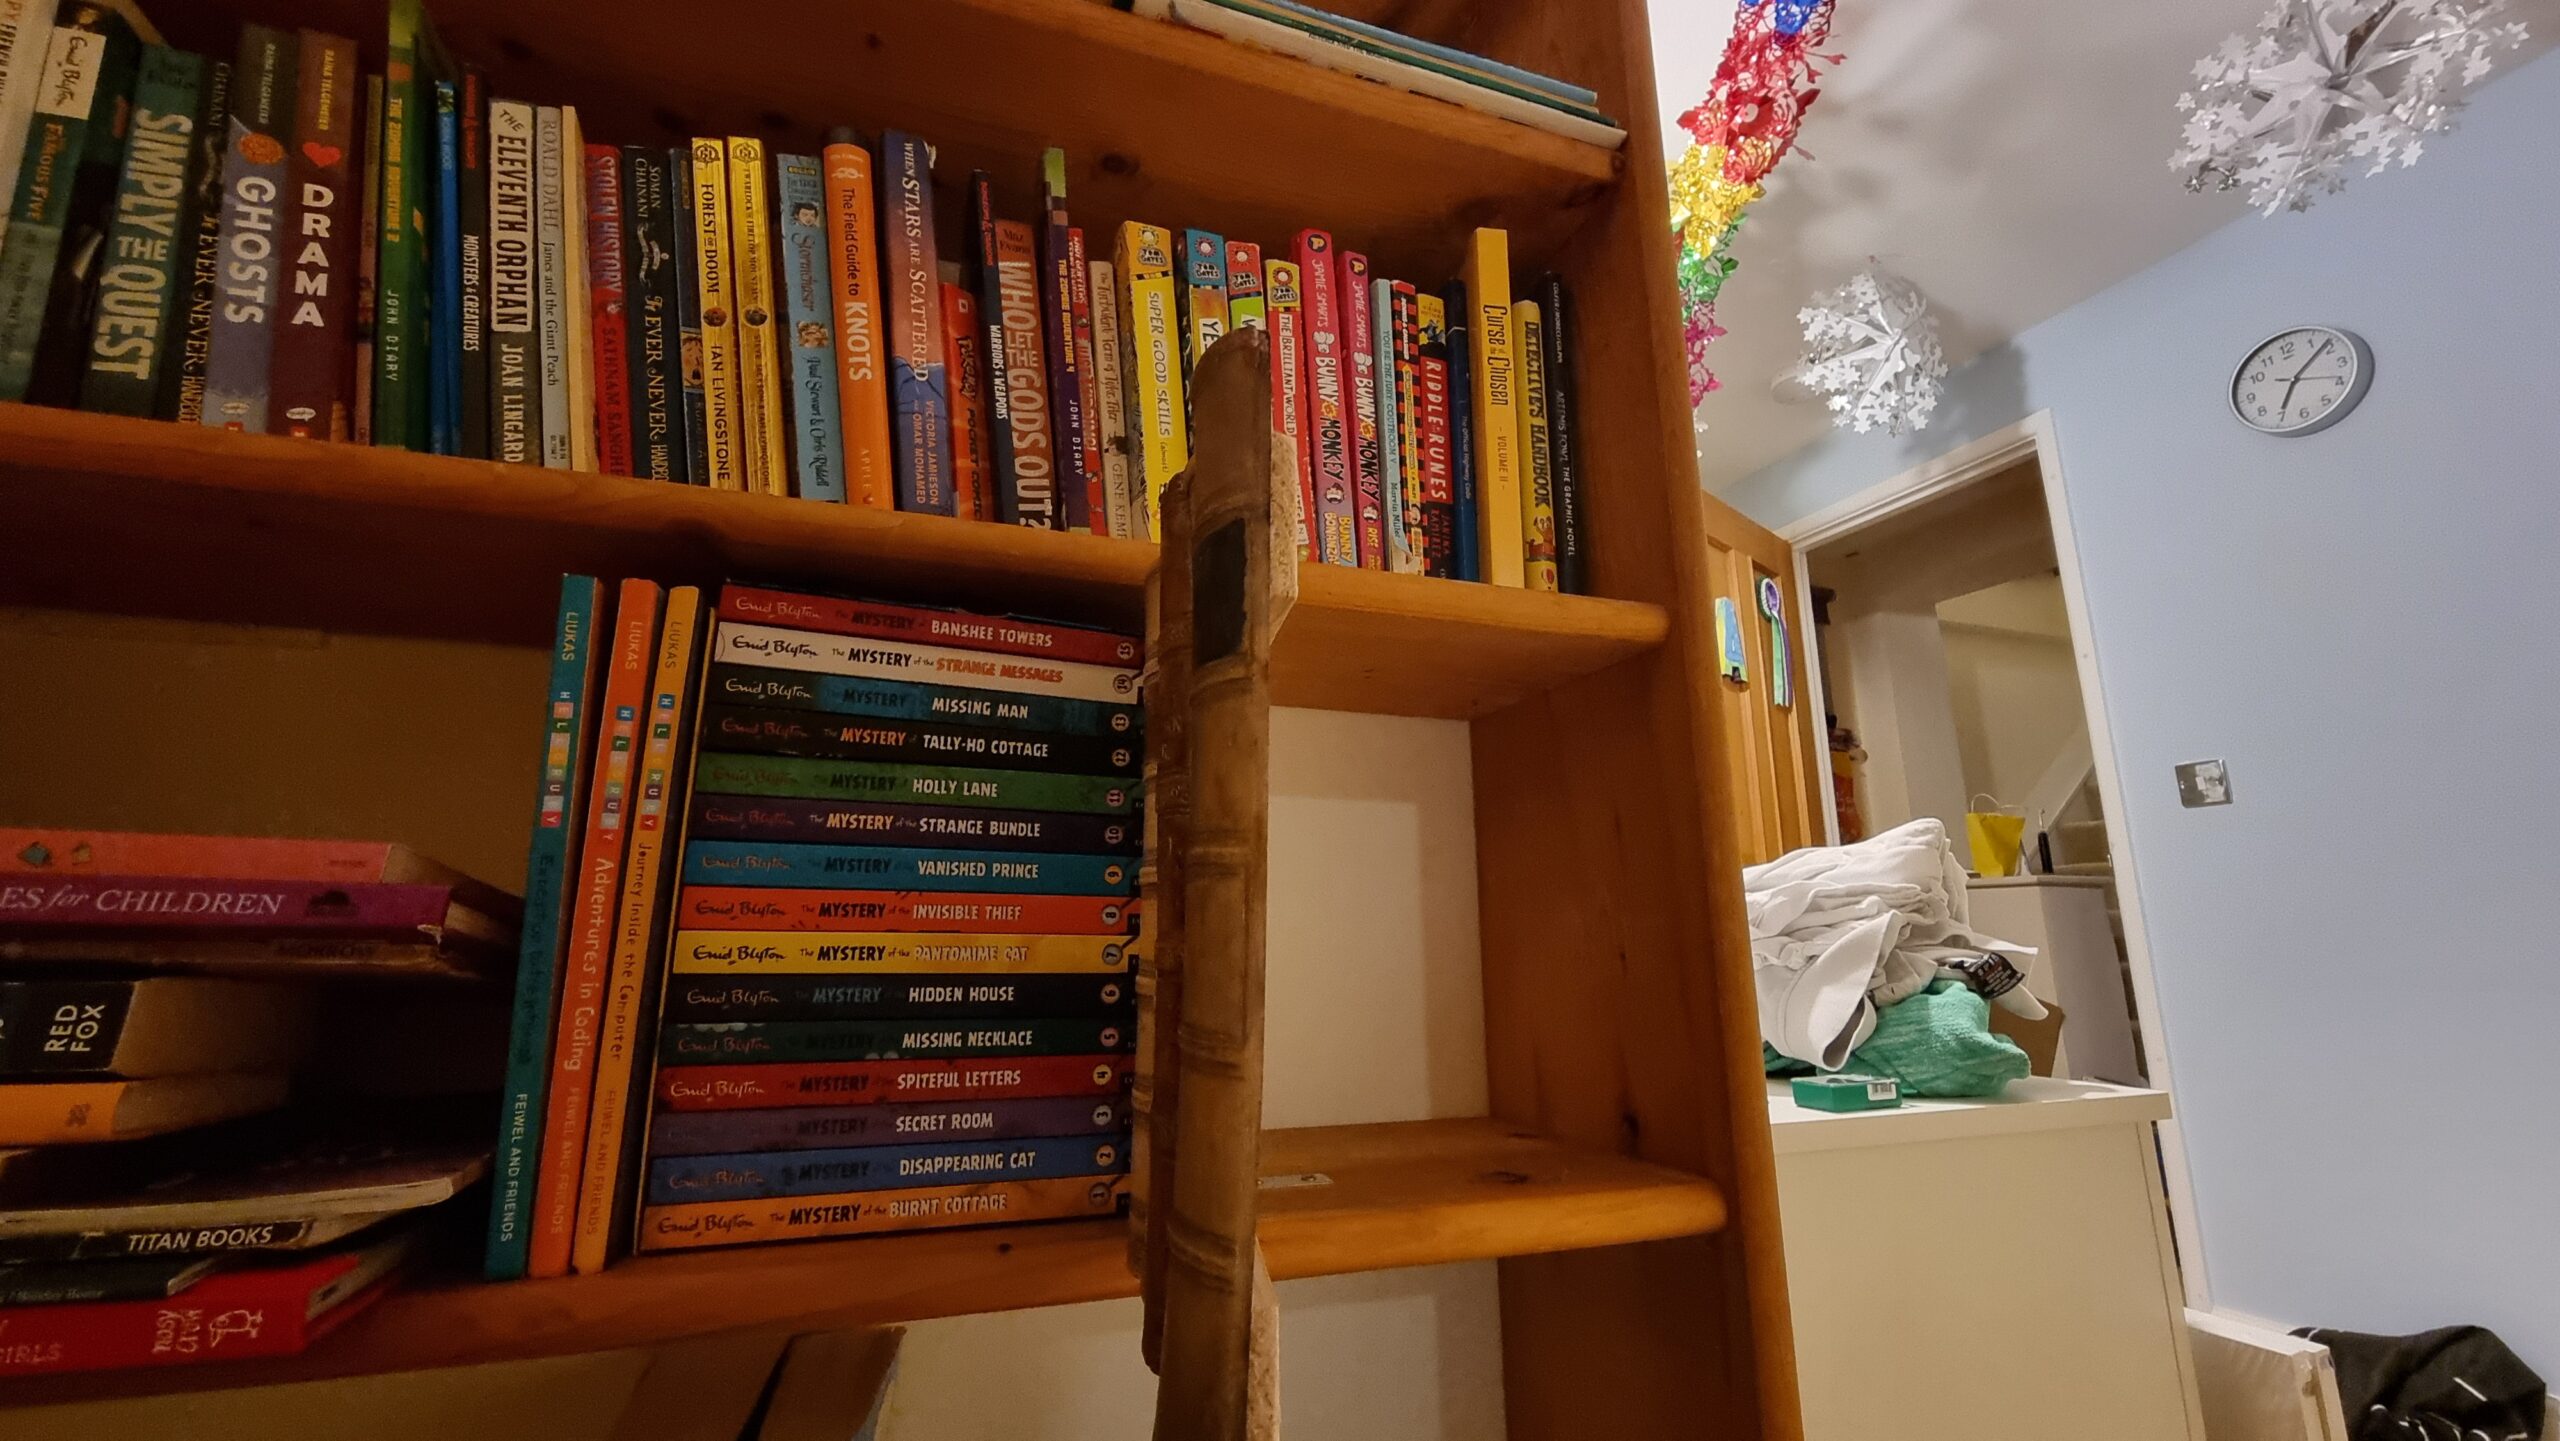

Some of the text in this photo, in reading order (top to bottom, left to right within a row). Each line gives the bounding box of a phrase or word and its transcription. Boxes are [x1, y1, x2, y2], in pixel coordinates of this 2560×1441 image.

[500, 108, 524, 132] THE
[116, 107, 193, 237] SIMPLY
[542, 119, 561, 232] ROALD DAHL
[117, 235, 170, 261] THE
[496, 134, 528, 326] ELEVENTH ORPHAN
[700, 183, 720, 294] FOREST DOOM
[224, 176, 277, 324] GHOSTS
[290, 183, 335, 328] DRAMA
[842, 211, 860, 297] Field Guide to
[901, 142, 930, 382] WHEN STARS ARE SCATTERED
[463, 234, 480, 351] MONSTERS CREATURES
[999, 260, 1038, 331] WHO
[91, 263, 167, 381] QUEST
[542, 241, 560, 386] James and Giant Peach
[385, 288, 400, 382] JOHN DIARY
[844, 301, 873, 382] KNOTS
[1006, 332, 1034, 349] LET
[2279, 341, 2296, 356] 12
[2307, 338, 2315, 349] 1
[2325, 342, 2335, 356] 2
[989, 325, 1009, 420] WARRIORS WEAPONS
[1007, 350, 1039, 368] THE
[1149, 292, 1171, 436] SUPER GOOD SKILLS
[1483, 304, 1511, 406] Curse Chosen
[2261, 355, 2275, 368] 11
[2336, 356, 2349, 369] 3
[1281, 316, 1296, 434] THE BRILLIANT WORLD
[2250, 371, 2266, 385] 10
[2334, 375, 2346, 387] 4
[502, 343, 525, 463] JOAN LINGARD
[710, 345, 731, 482] IAN LIVINGSTONE
[2246, 392, 2257, 404] 9
[2257, 405, 2268, 417] 8
[2277, 410, 2287, 423] 7
[2299, 407, 2310, 419] 6
[2321, 394, 2332, 407] 5
[1069, 400, 1084, 476] JOHN DIARY
[1315, 357, 1345, 481] BUNNY MONKEY
[1425, 360, 1447, 500] RIDDLE RUNES
[923, 399, 940, 506] VICTORIA JAMIESON
[1007, 367, 1053, 529] GODS OUT?
[1354, 376, 1381, 502] BUNNY MONKEY
[1497, 435, 1509, 473] VOLUME
[1558, 433, 1570, 463] FOWL
[912, 413, 927, 504] OMAR MOHAMED
[1530, 424, 1551, 509] HANDBOOK
[1562, 466, 1571, 483] THE
[1112, 463, 1125, 502] GENE
[1389, 482, 1400, 512] Marvin
[1563, 486, 1574, 524] GRAPHIC
[1337, 515, 1352, 563] BUNNY
[1367, 527, 1379, 549] RISE
[1566, 528, 1576, 556] NOVEL
[561, 611, 579, 661] LIUKAS
[625, 621, 643, 671] LIUKAS
[664, 620, 683, 669] LIUKAS
[851, 611, 1054, 648] MYSTERY BANSHEE TOWERS
[848, 647, 1064, 684] MYSTERY STRANGE MESSAGES
[932, 697, 1030, 720] MISSING MAN
[840, 727, 1050, 759] MYSTERY TALLY-HO COTTAGE
[829, 773, 1000, 798] MYSTERY HOLLY LANE
[826, 812, 1042, 838] MYSTERY STRANGE BUNDLE
[918, 859, 1040, 879] VANISHED PRINCE
[39, 884, 91, 912] for
[94, 889, 288, 917] CHILDREN
[818, 902, 1023, 921] MYSTERY INVISIBLE THIEF
[563, 857, 616, 1072] Adventures Coding
[610, 842, 652, 1061] Journey Inside Computer
[693, 944, 1030, 966] Enid Blyton MYSTERY PANTOMIME CAT
[812, 986, 1015, 1004] MYSTERY HIDDEN HOUSE
[43, 1004, 79, 1053] RED
[69, 1004, 108, 1053] FOX
[902, 1030, 1034, 1049] MISSING NECKLACE
[799, 1069, 1022, 1094] MYSTERY SPITEFUL LETTERS
[895, 1112, 995, 1133] SECRET ROOM
[500, 1093, 529, 1243] FEIWEL AND FRIENDS
[900, 1151, 1037, 1177] DISAPPEARING CAT
[788, 1194, 1008, 1226] MYSTERY BURNT COTTAGE
[127, 1225, 273, 1254] TITAN BOOKS
[0, 1343, 64, 1364] IRLS
